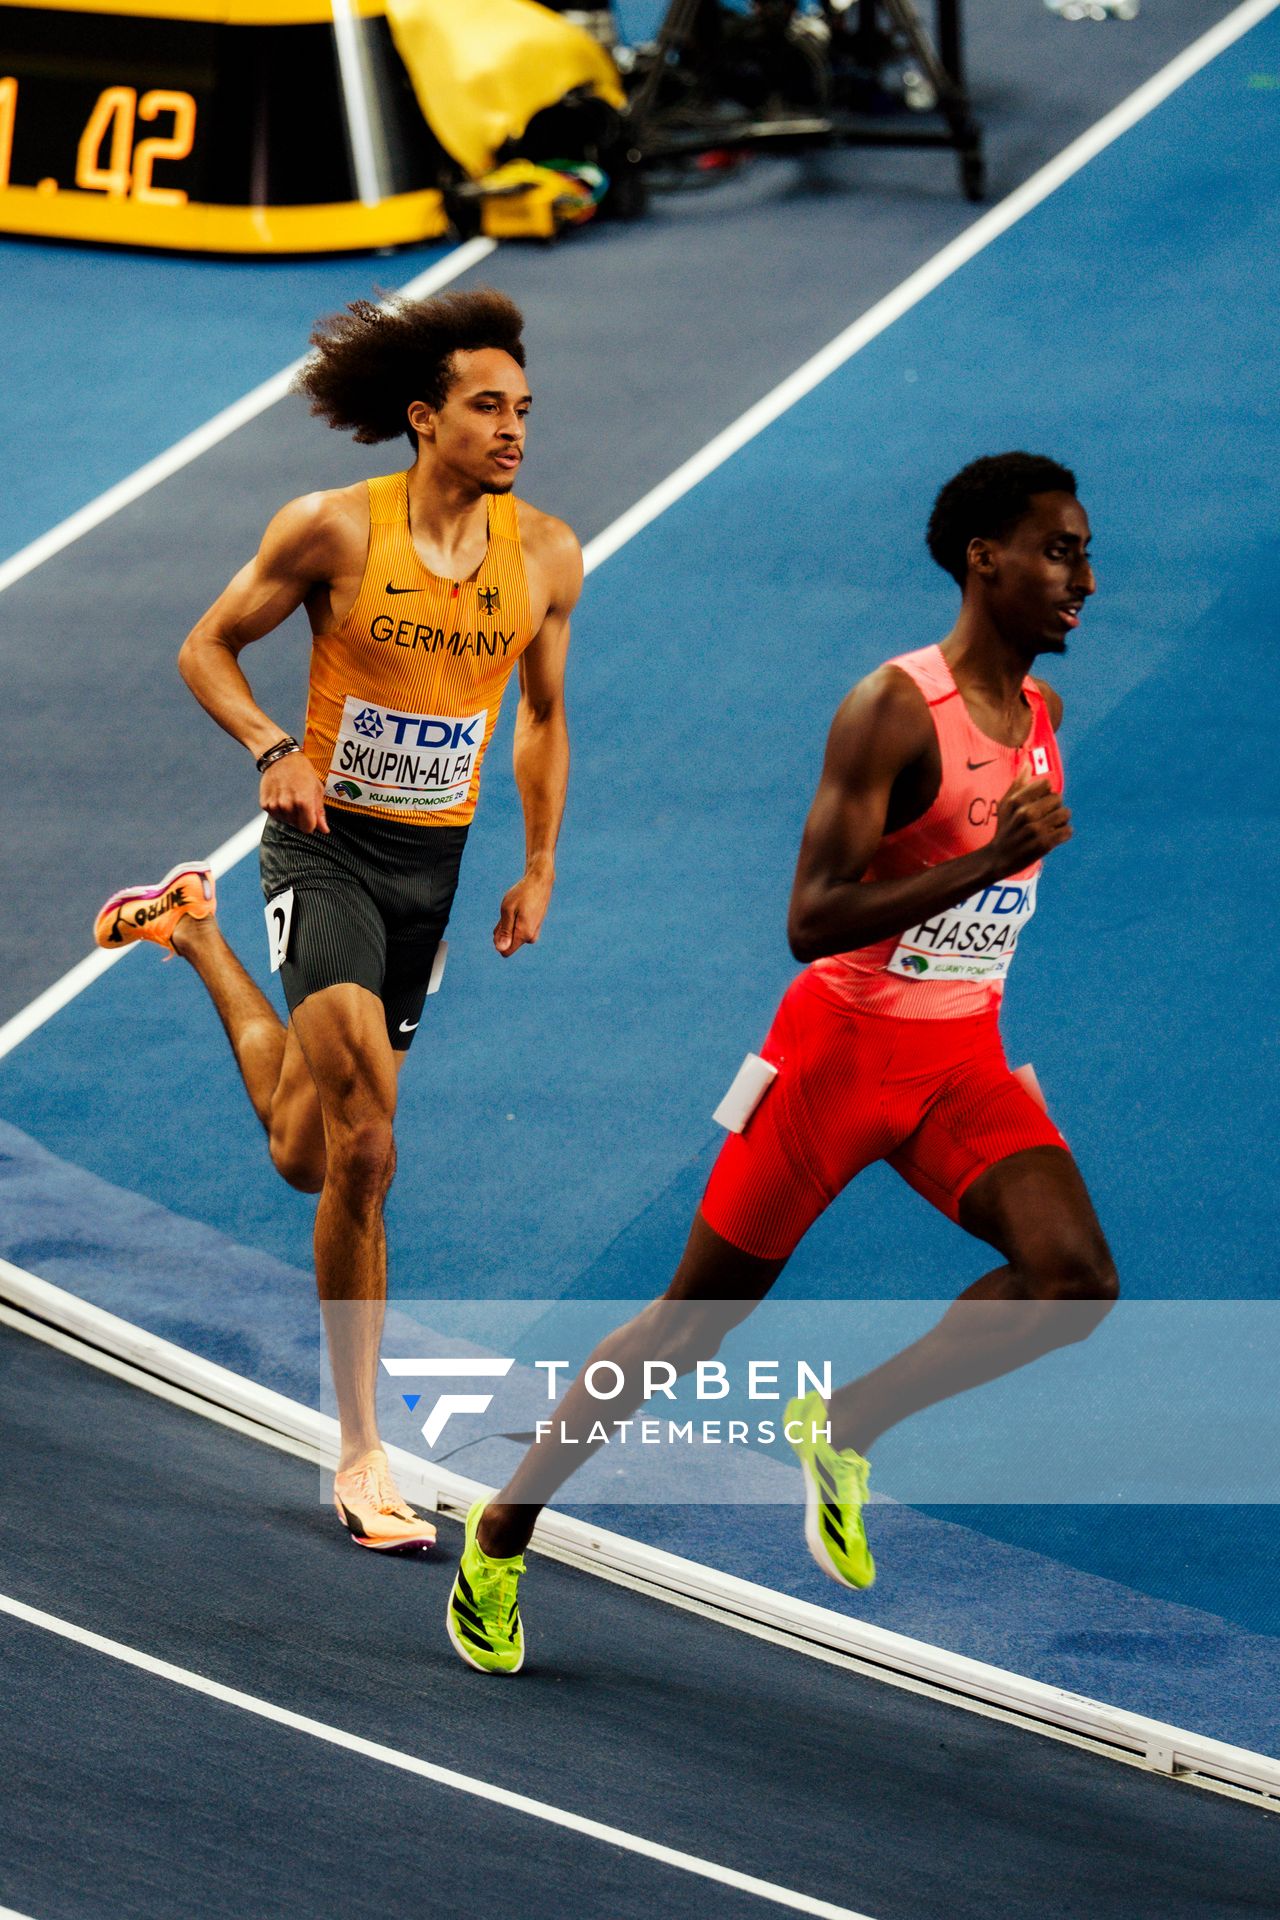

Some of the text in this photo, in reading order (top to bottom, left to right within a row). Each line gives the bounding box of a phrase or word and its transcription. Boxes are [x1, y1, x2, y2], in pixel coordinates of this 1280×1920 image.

[370, 615, 515, 656] GERMANY
[386, 714, 479, 749] TDK
[340, 740, 471, 785] SKUPIN-ALFA
[369, 792, 411, 803] KUJAWY
[412, 794, 453, 805] POMORZE
[134, 886, 191, 926] NITRO
